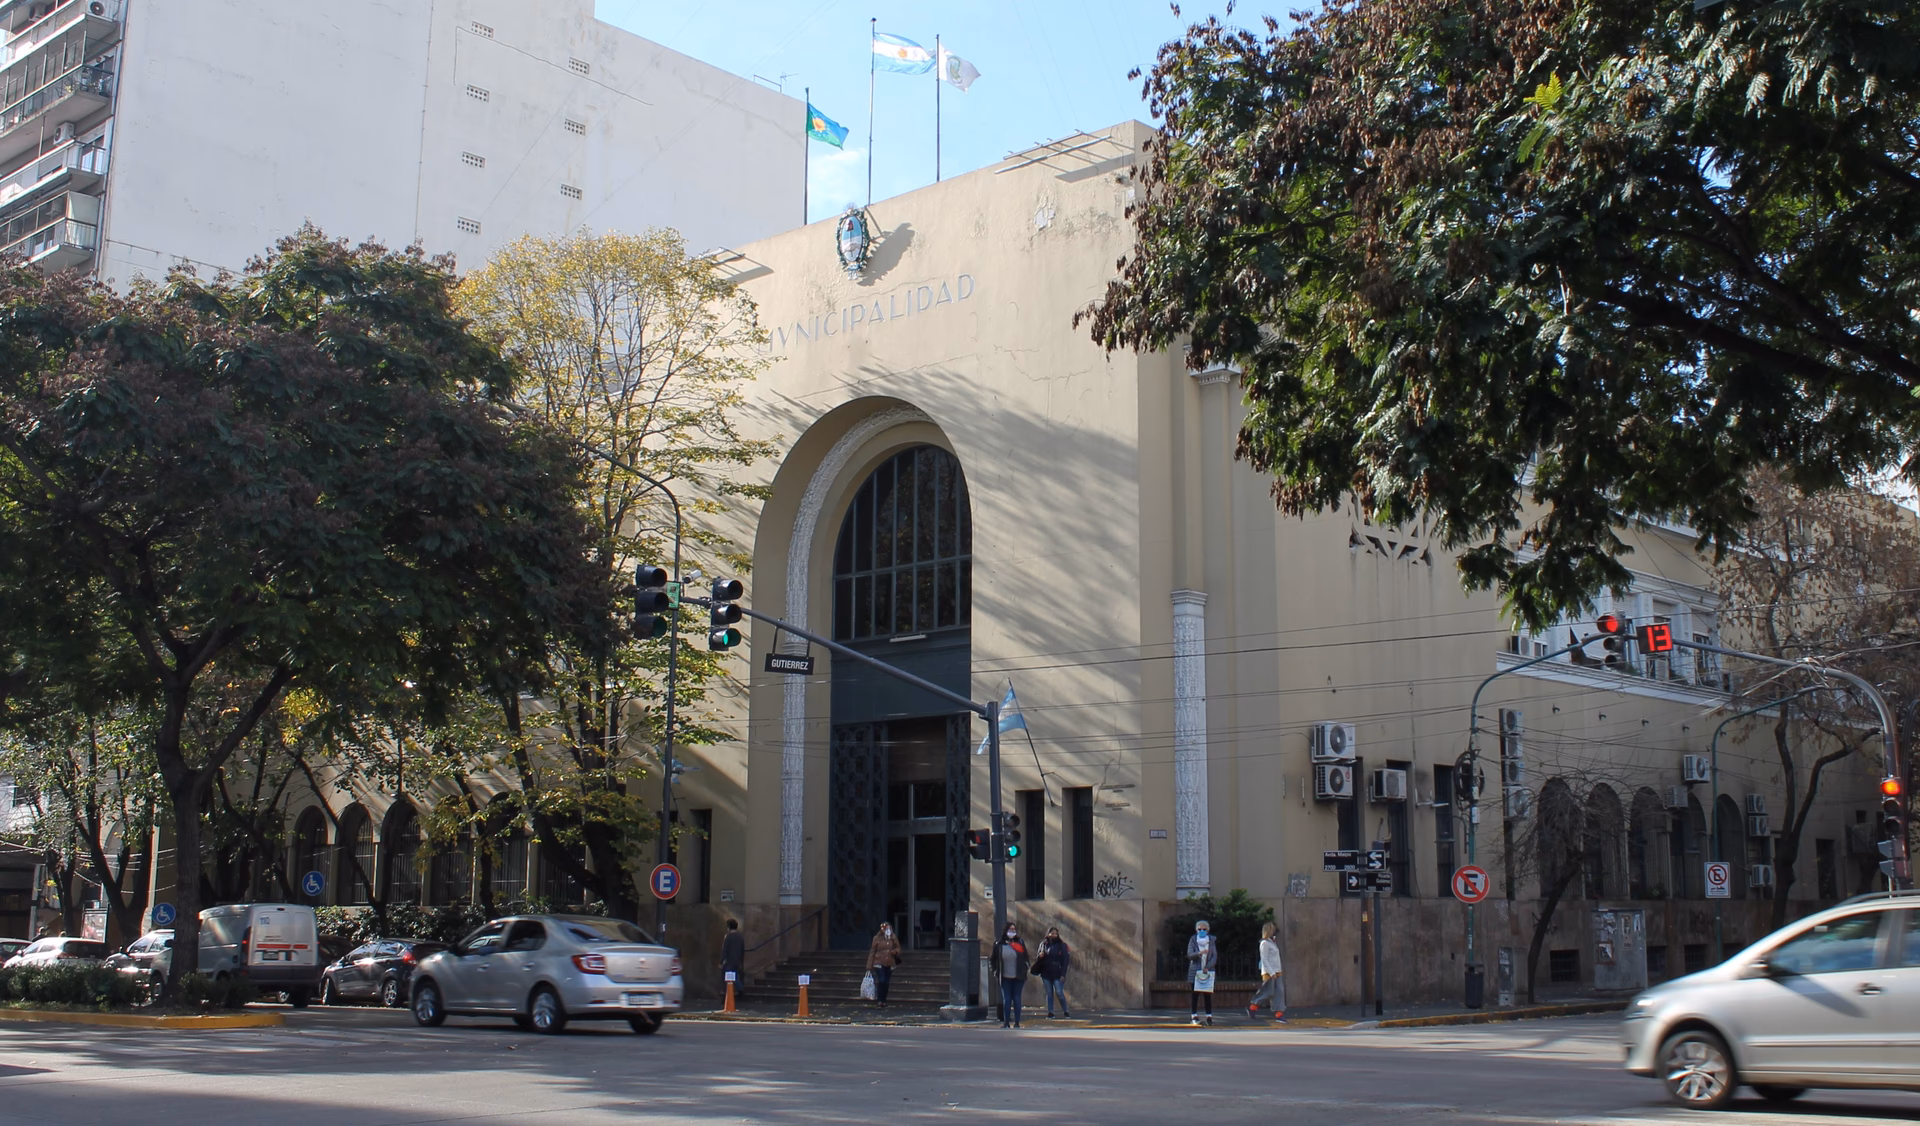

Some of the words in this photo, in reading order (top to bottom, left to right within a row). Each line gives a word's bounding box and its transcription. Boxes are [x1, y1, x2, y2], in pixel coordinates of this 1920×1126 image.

[1647, 625, 1673, 652] 13
[771, 658, 809, 670] GUTIERREZ
[659, 871, 672, 892] E
